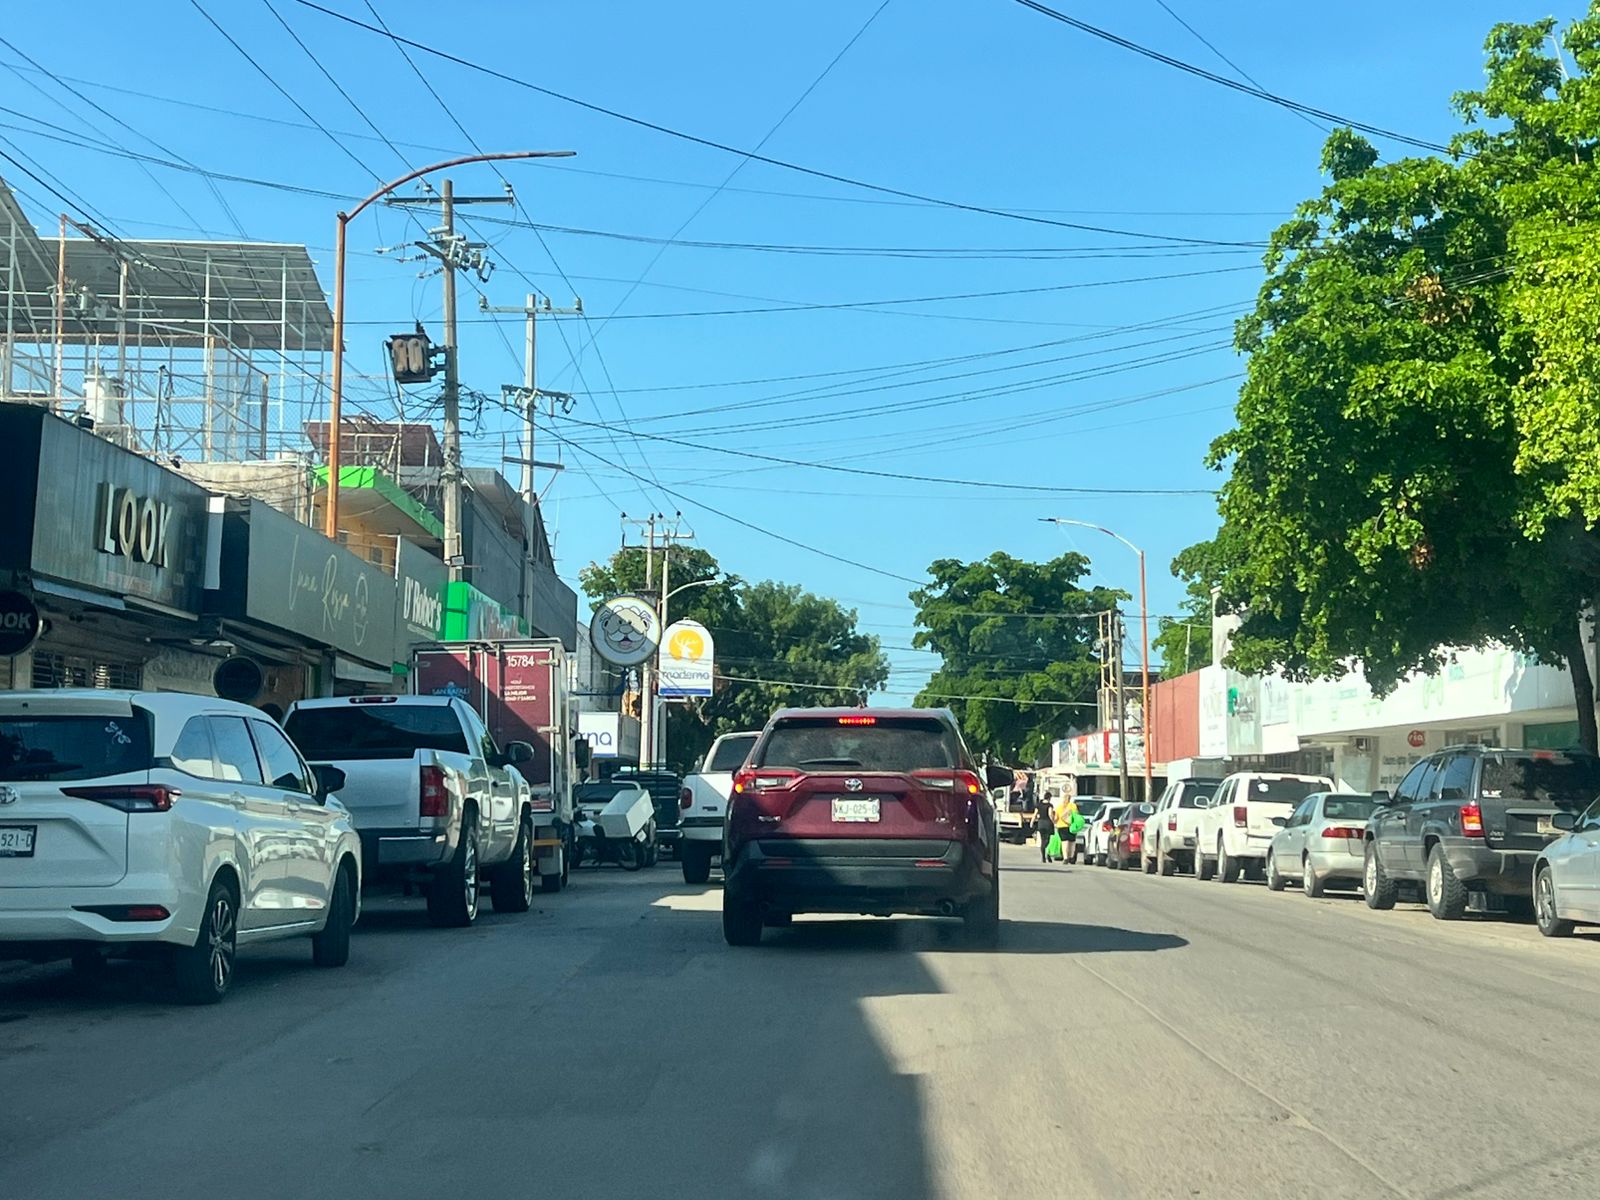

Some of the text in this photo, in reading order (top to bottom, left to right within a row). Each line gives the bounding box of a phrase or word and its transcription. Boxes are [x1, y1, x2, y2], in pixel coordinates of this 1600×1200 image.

[99, 482, 172, 568] LOOK
[0, 612, 31, 629] OK
[505, 654, 535, 667] 15784
